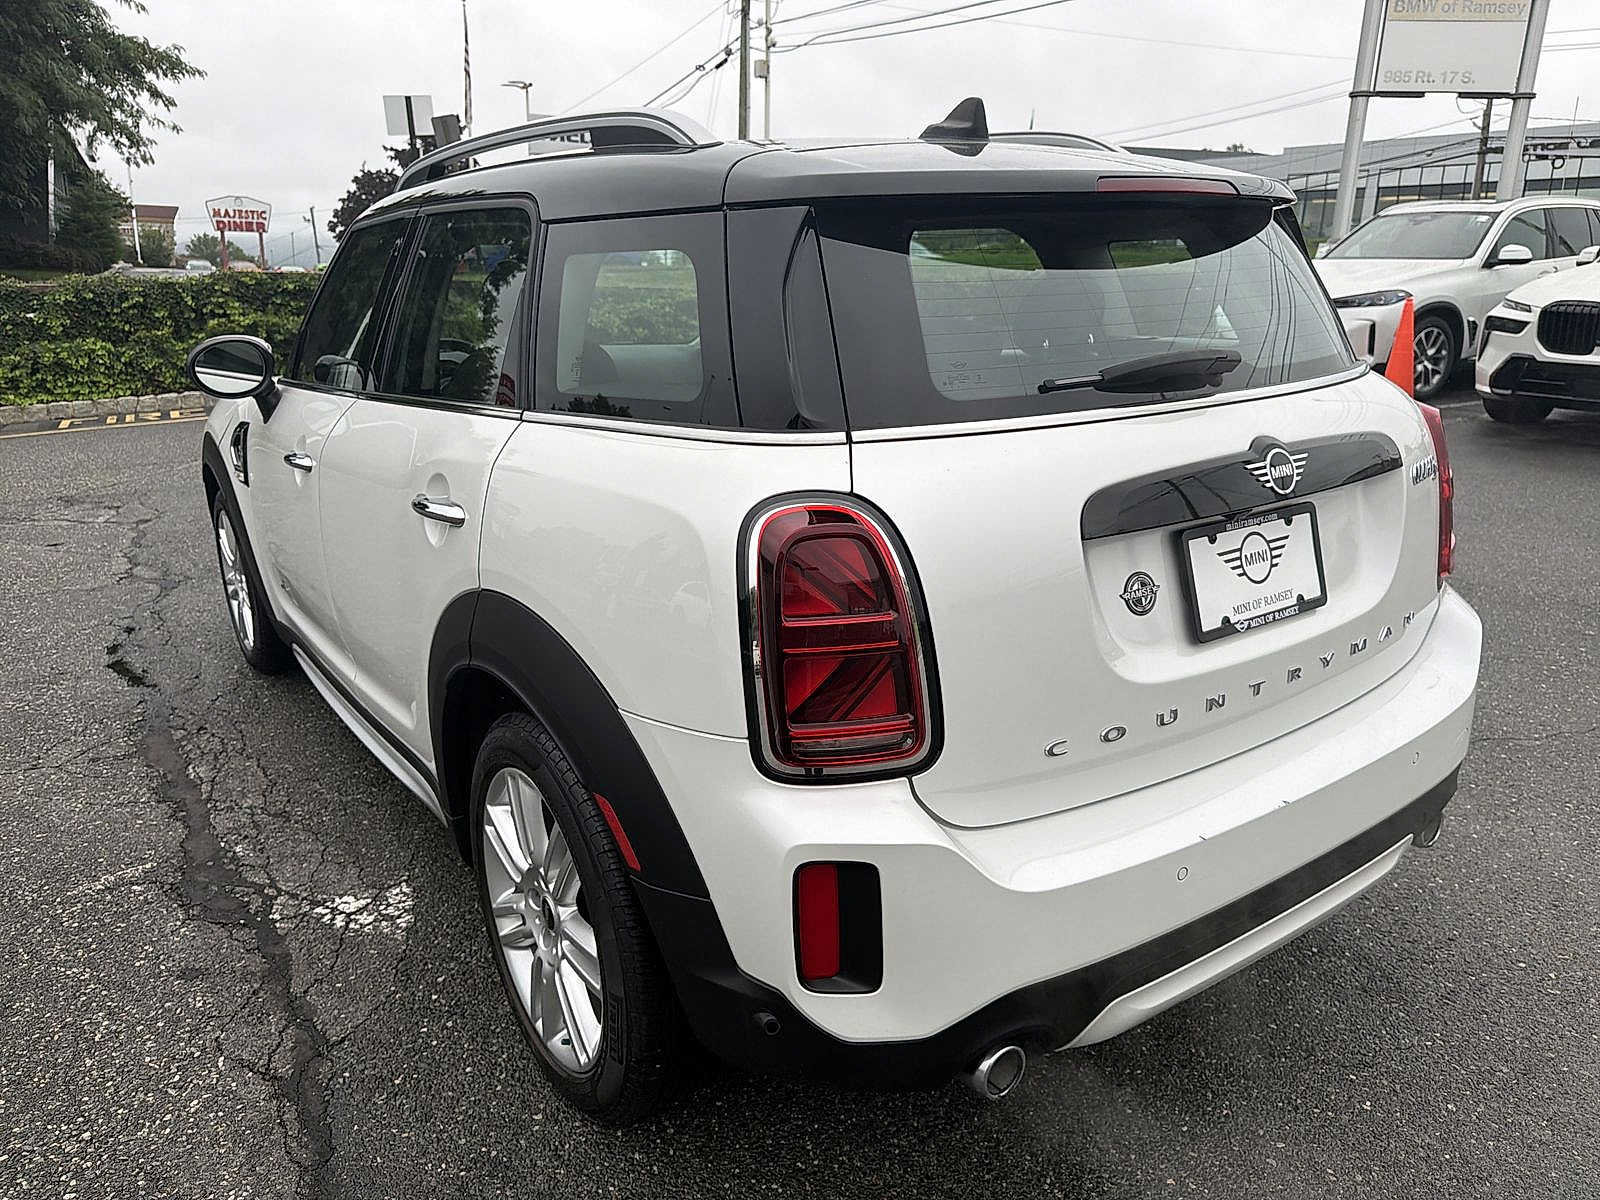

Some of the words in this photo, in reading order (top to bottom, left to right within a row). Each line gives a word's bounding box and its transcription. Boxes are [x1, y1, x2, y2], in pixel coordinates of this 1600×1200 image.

[1393, 0, 1437, 13] BMW
[1441, 0, 1459, 13] of
[1463, 0, 1526, 15] Ramsey
[1383, 70, 1412, 84] 985
[1415, 70, 1436, 84] Rt.
[1441, 71, 1459, 84] 17
[1460, 71, 1476, 84] S.
[212, 207, 267, 220] MAJESTIC
[215, 220, 268, 232] DINER
[1270, 463, 1295, 479] MINI
[1225, 513, 1279, 531] miniramsey.com
[1244, 549, 1269, 568] MINI
[1122, 585, 1159, 601] RAMSEY
[1232, 602, 1252, 616] MINI
[1252, 598, 1263, 611] OF
[1263, 588, 1294, 607] RAMSEY
[1249, 615, 1265, 628] MINI
[1265, 612, 1275, 622] OF
[1275, 605, 1300, 620] RAMSEY
